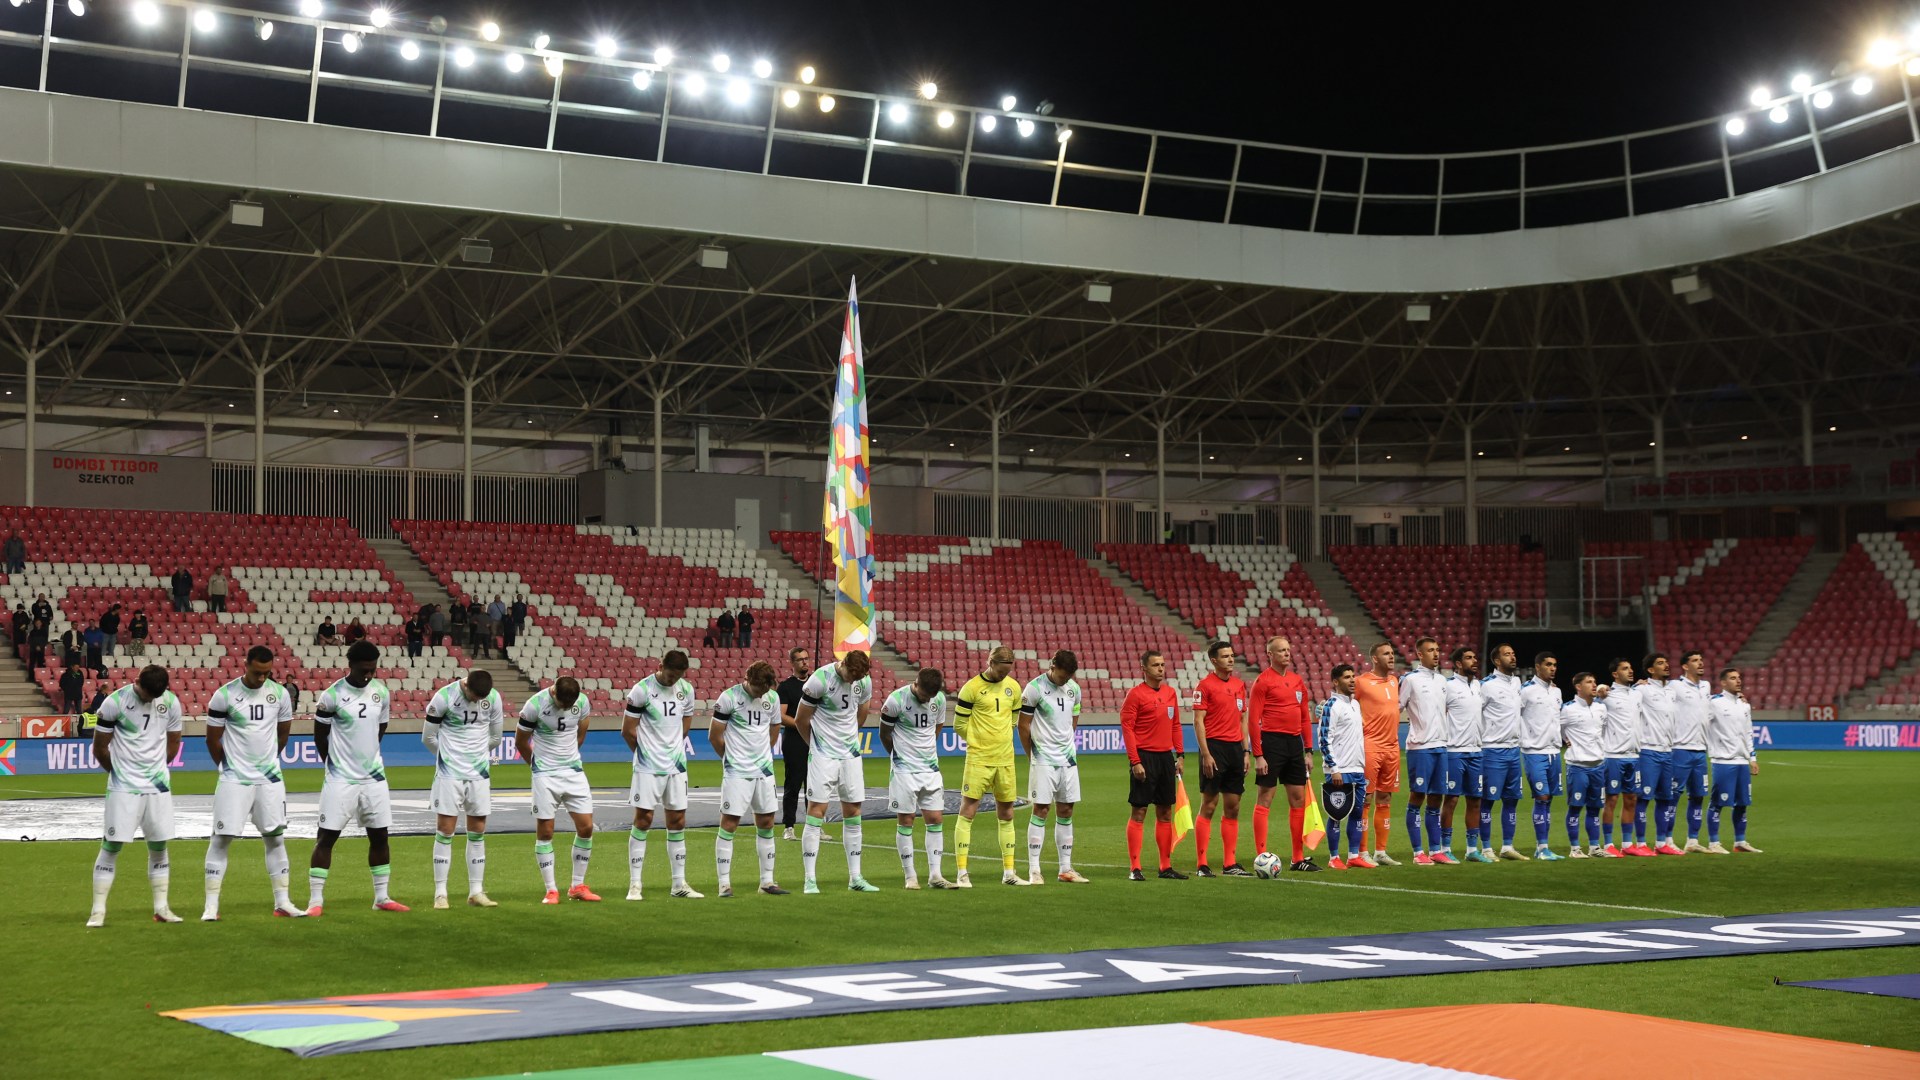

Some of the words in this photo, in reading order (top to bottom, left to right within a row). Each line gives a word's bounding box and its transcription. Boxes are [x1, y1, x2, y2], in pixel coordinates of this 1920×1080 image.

[53, 457, 105, 472] DOMBI
[110, 459, 158, 473] TIBOR
[78, 474, 134, 485] SZEKTOR
[1489, 603, 1515, 620] B9
[841, 694, 849, 710] 5
[1386, 688, 1391, 700] 1
[249, 704, 264, 721] 10
[358, 703, 367, 718] 2
[663, 702, 676, 717] 12
[994, 698, 1000, 712] 1
[1057, 698, 1065, 712] 4
[143, 714, 151, 730] 7
[463, 710, 478, 726] 17
[557, 717, 566, 731] 6
[748, 710, 761, 725] 14
[914, 713, 928, 728] 18
[27, 719, 64, 738] C4
[1752, 725, 1772, 745] FA
[942, 733, 968, 752] UE
[1074, 729, 1125, 751] #FOOTB
[47, 743, 101, 769] WELC
[281, 742, 323, 764] UE
[576, 853, 589, 862] ÉIR
[632, 856, 643, 864] ÉIR
[676, 853, 686, 861] ÉIR
[571, 958, 1301, 1013] UEFA
